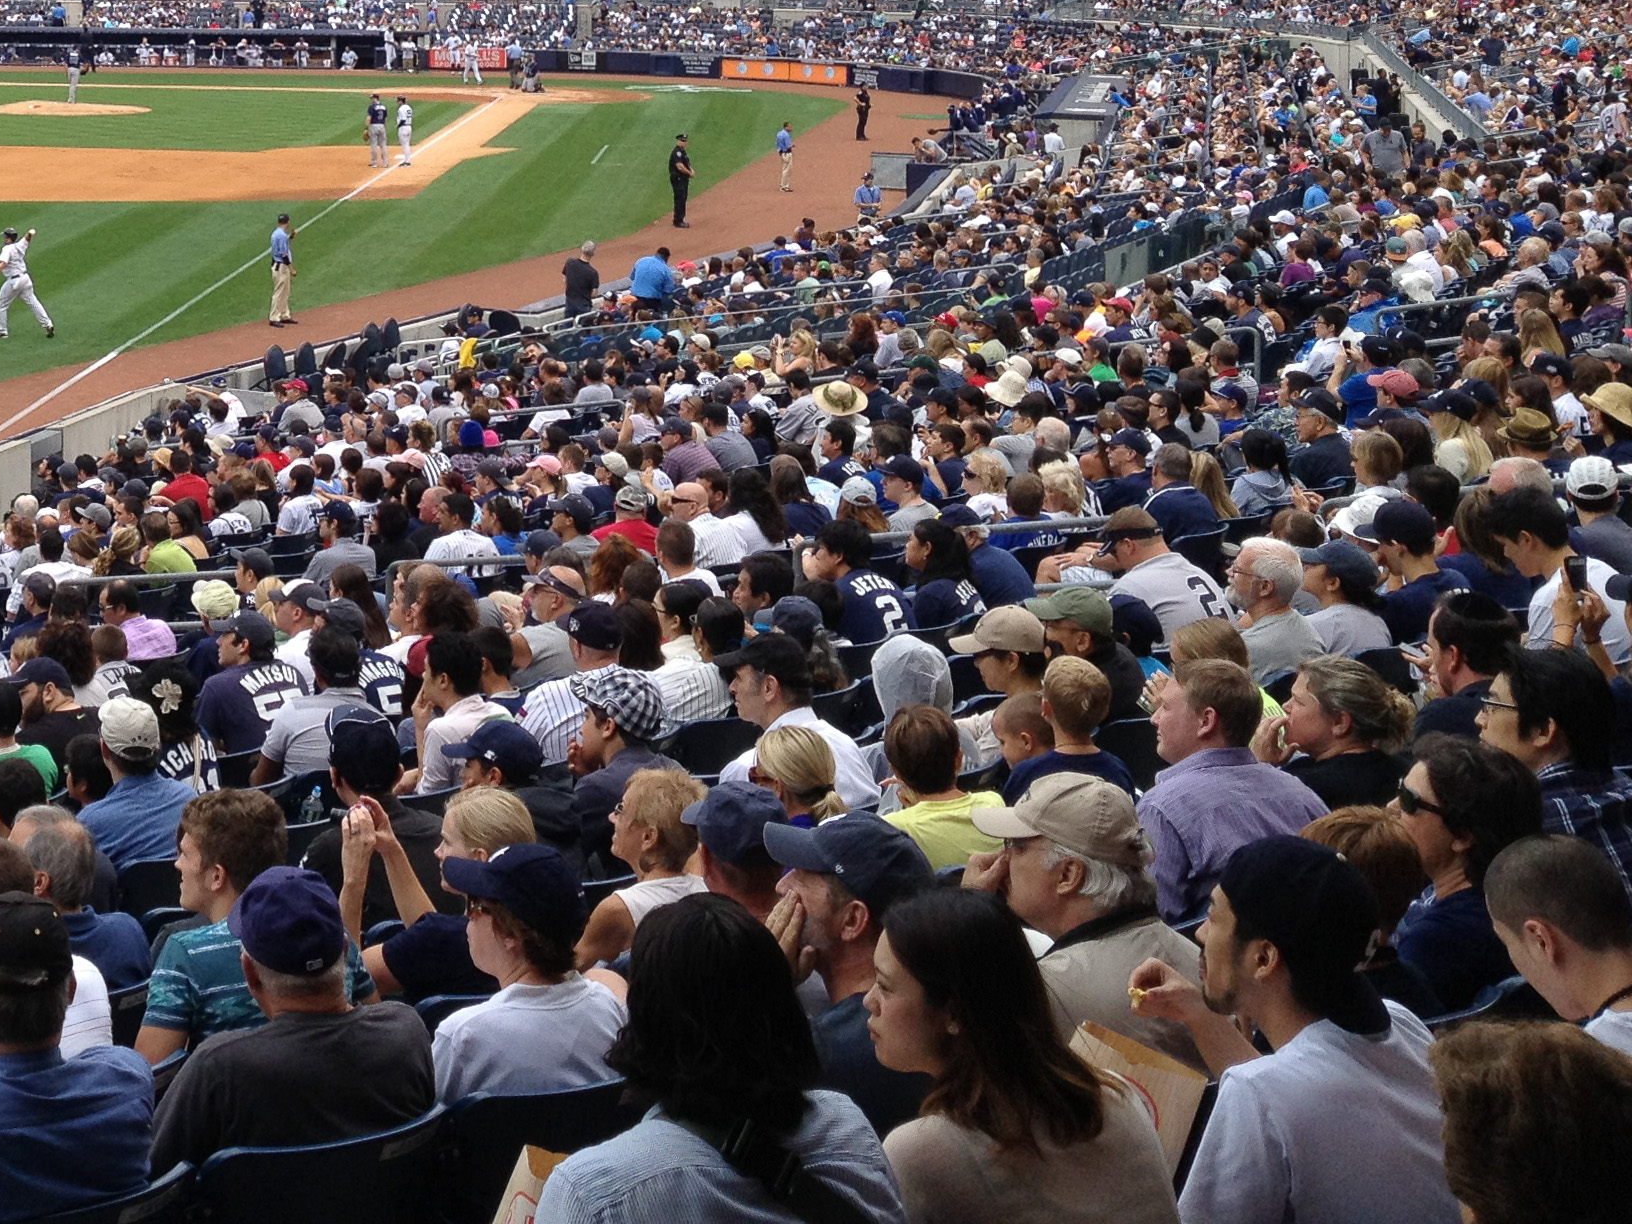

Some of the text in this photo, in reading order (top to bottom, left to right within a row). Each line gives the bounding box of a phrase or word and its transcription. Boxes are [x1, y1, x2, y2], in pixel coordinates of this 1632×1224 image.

[850, 574, 896, 596] JETER
[1186, 575, 1232, 623] 2
[875, 594, 909, 635] 2
[239, 664, 298, 695] MATSUI
